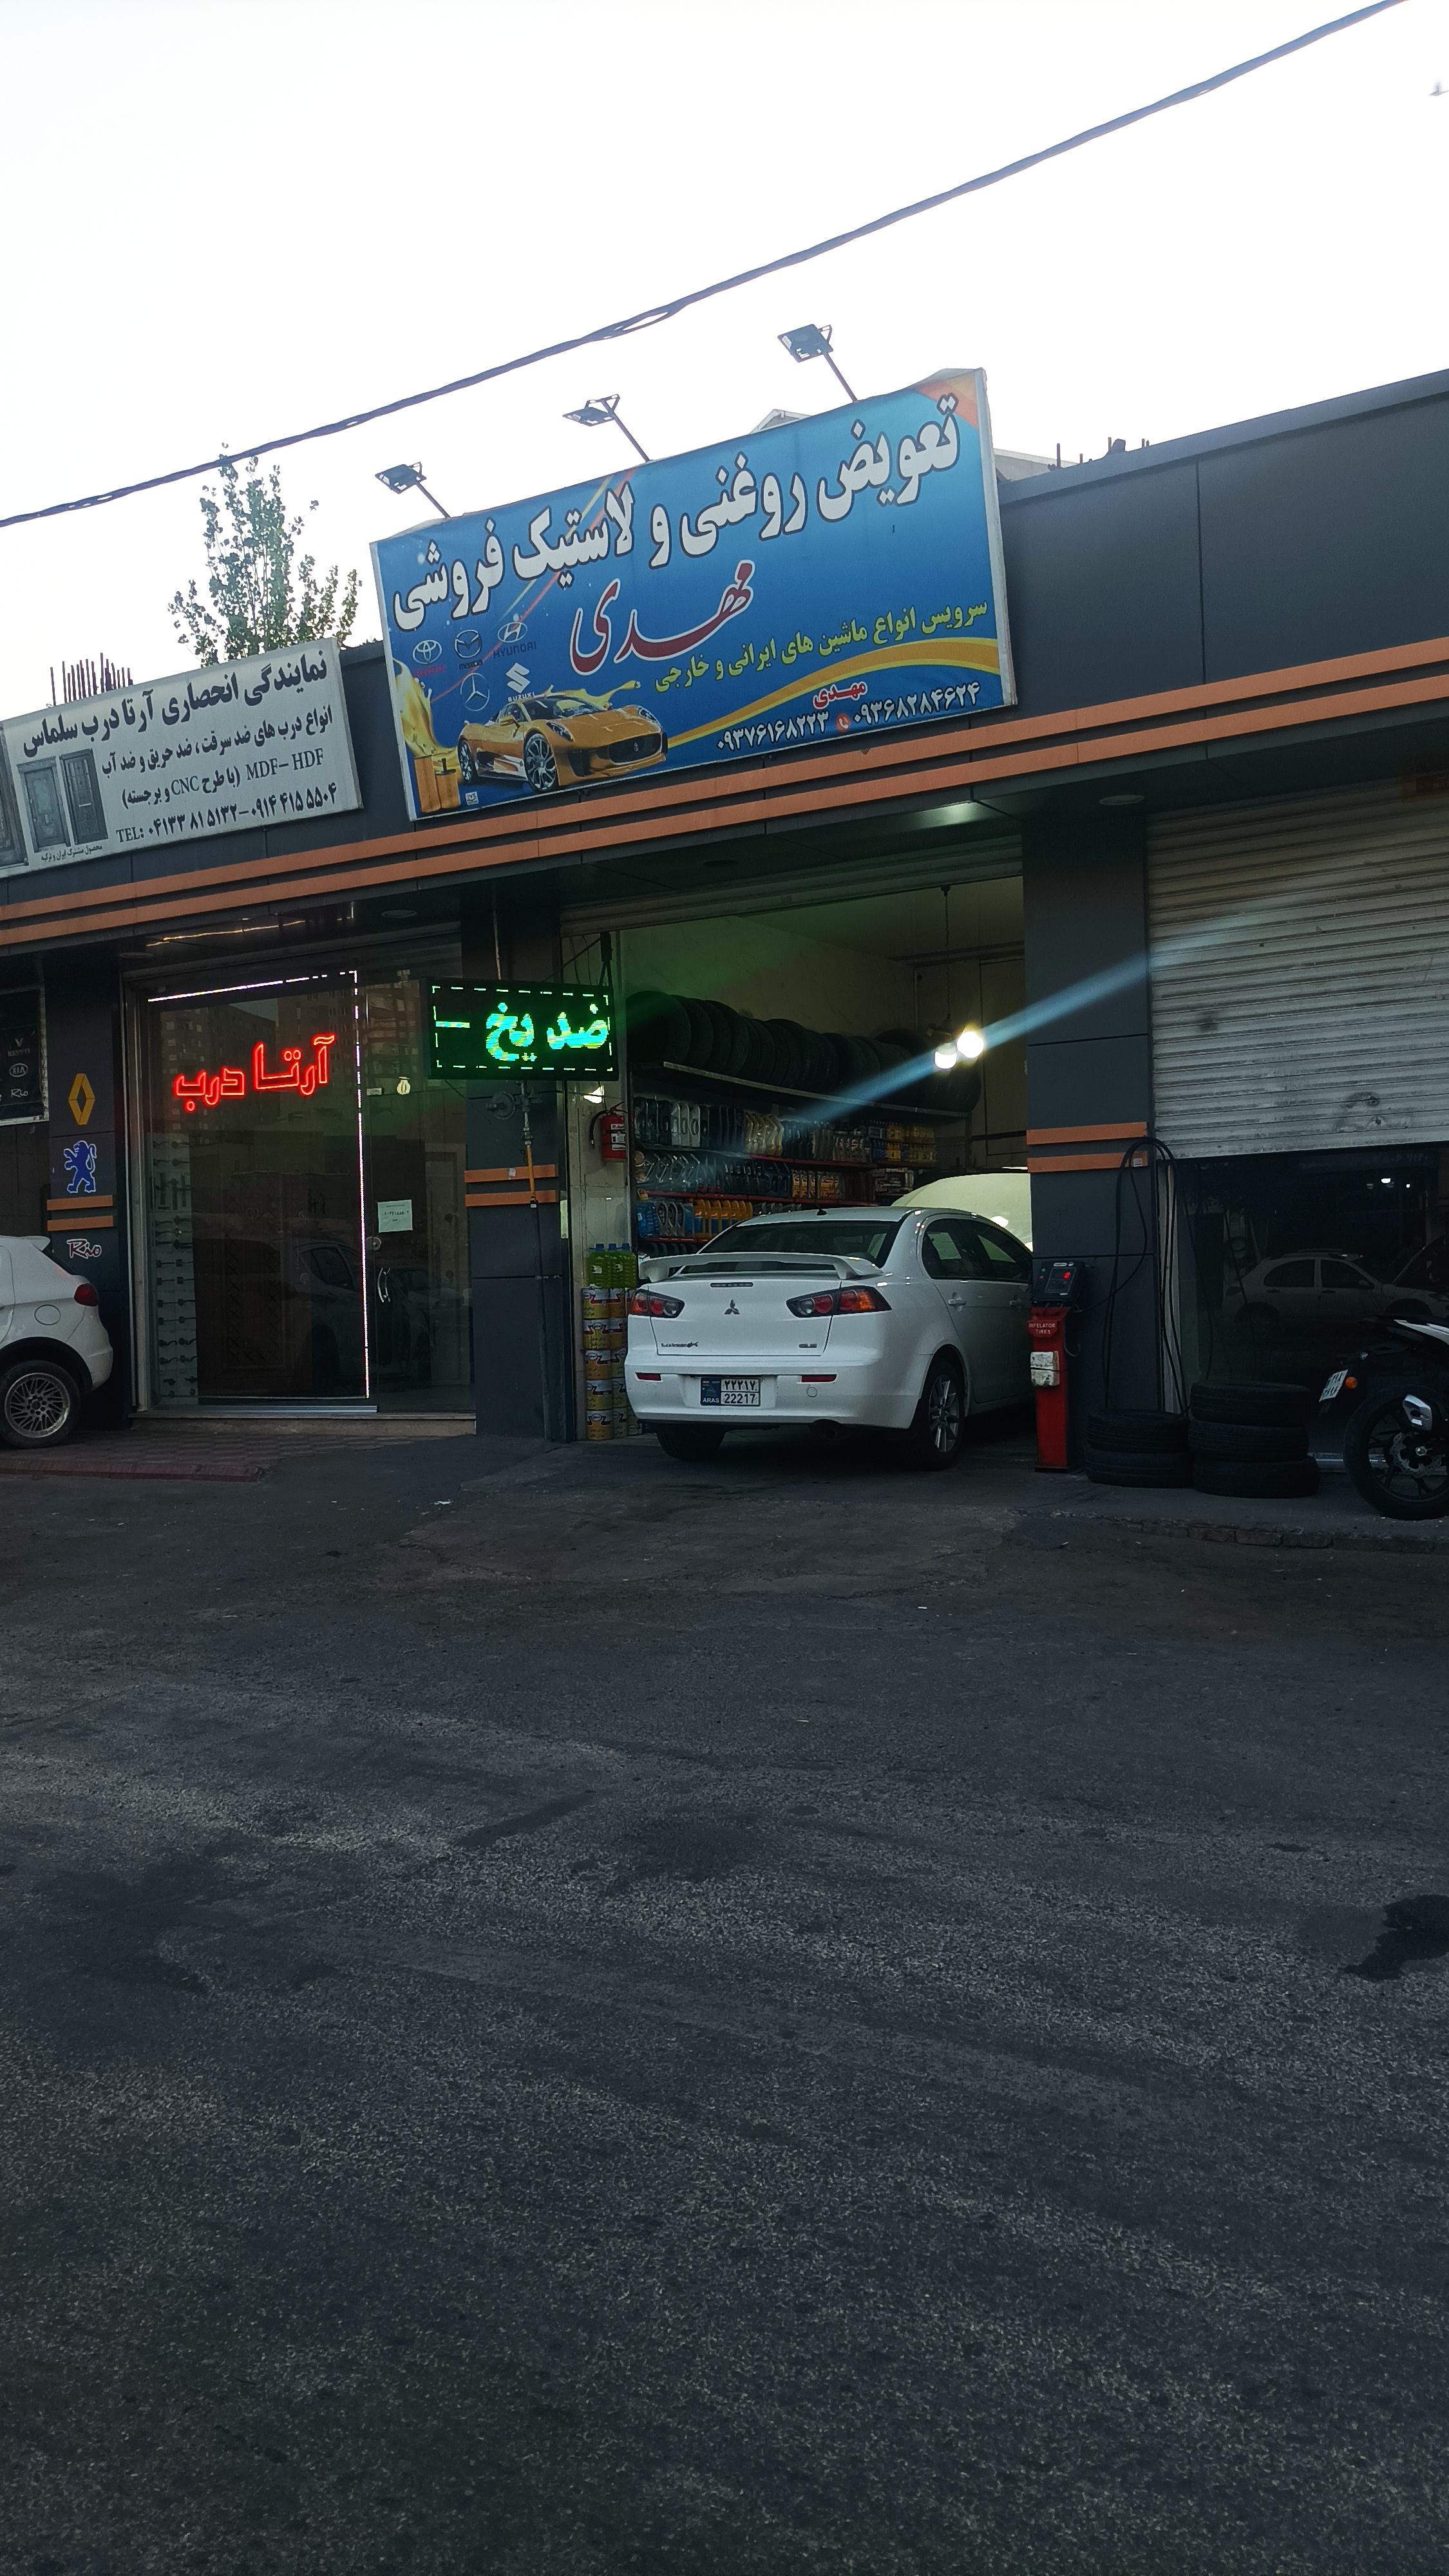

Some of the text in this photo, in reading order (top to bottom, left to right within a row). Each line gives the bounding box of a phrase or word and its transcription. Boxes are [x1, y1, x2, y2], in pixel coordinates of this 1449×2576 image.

[393, 393, 961, 632] تعویض روغنی و لاستیک فروشی
[493, 641, 536, 659] HYUNDAI
[655, 601, 988, 692] سرویس انواع ماشین های ایرانی و خارجی
[244, 650, 327, 706] نمایندگی
[162, 672, 239, 725] انحصاری
[507, 692, 535, 703] SUZUKI
[813, 681, 867, 709] مهدی
[853, 681, 981, 724] ۰۹۳۶۸۲۸۴۶۲۴
[82, 708, 120, 742] درب
[278, 716, 301, 740] درب
[306, 704, 332, 735] انواع
[717, 711, 829, 751] ۰۹۳۷۶۱۶۸۲۲۳
[23, 714, 78, 757] سلماس
[234, 725, 251, 746] ضد
[254, 720, 275, 747] های
[147, 748, 173, 770] حریق
[176, 738, 192, 759] ضد
[102, 752, 116, 779] آب
[120, 751, 136, 770] ضد
[140, 756, 146, 773] و
[171, 775, 200, 795] CNC
[202, 770, 225, 793] طرح
[164, 788, 170, 802] و
[116, 826, 144, 842] TEL:
[85, 845, 102, 855] محصول
[175, 1034, 335, 1112] آرتا درب
[66, 1239, 102, 1259] Rio
[724, 1380, 756, 1391] ۲۲۲۱۷
[724, 1394, 756, 1404] 22217
